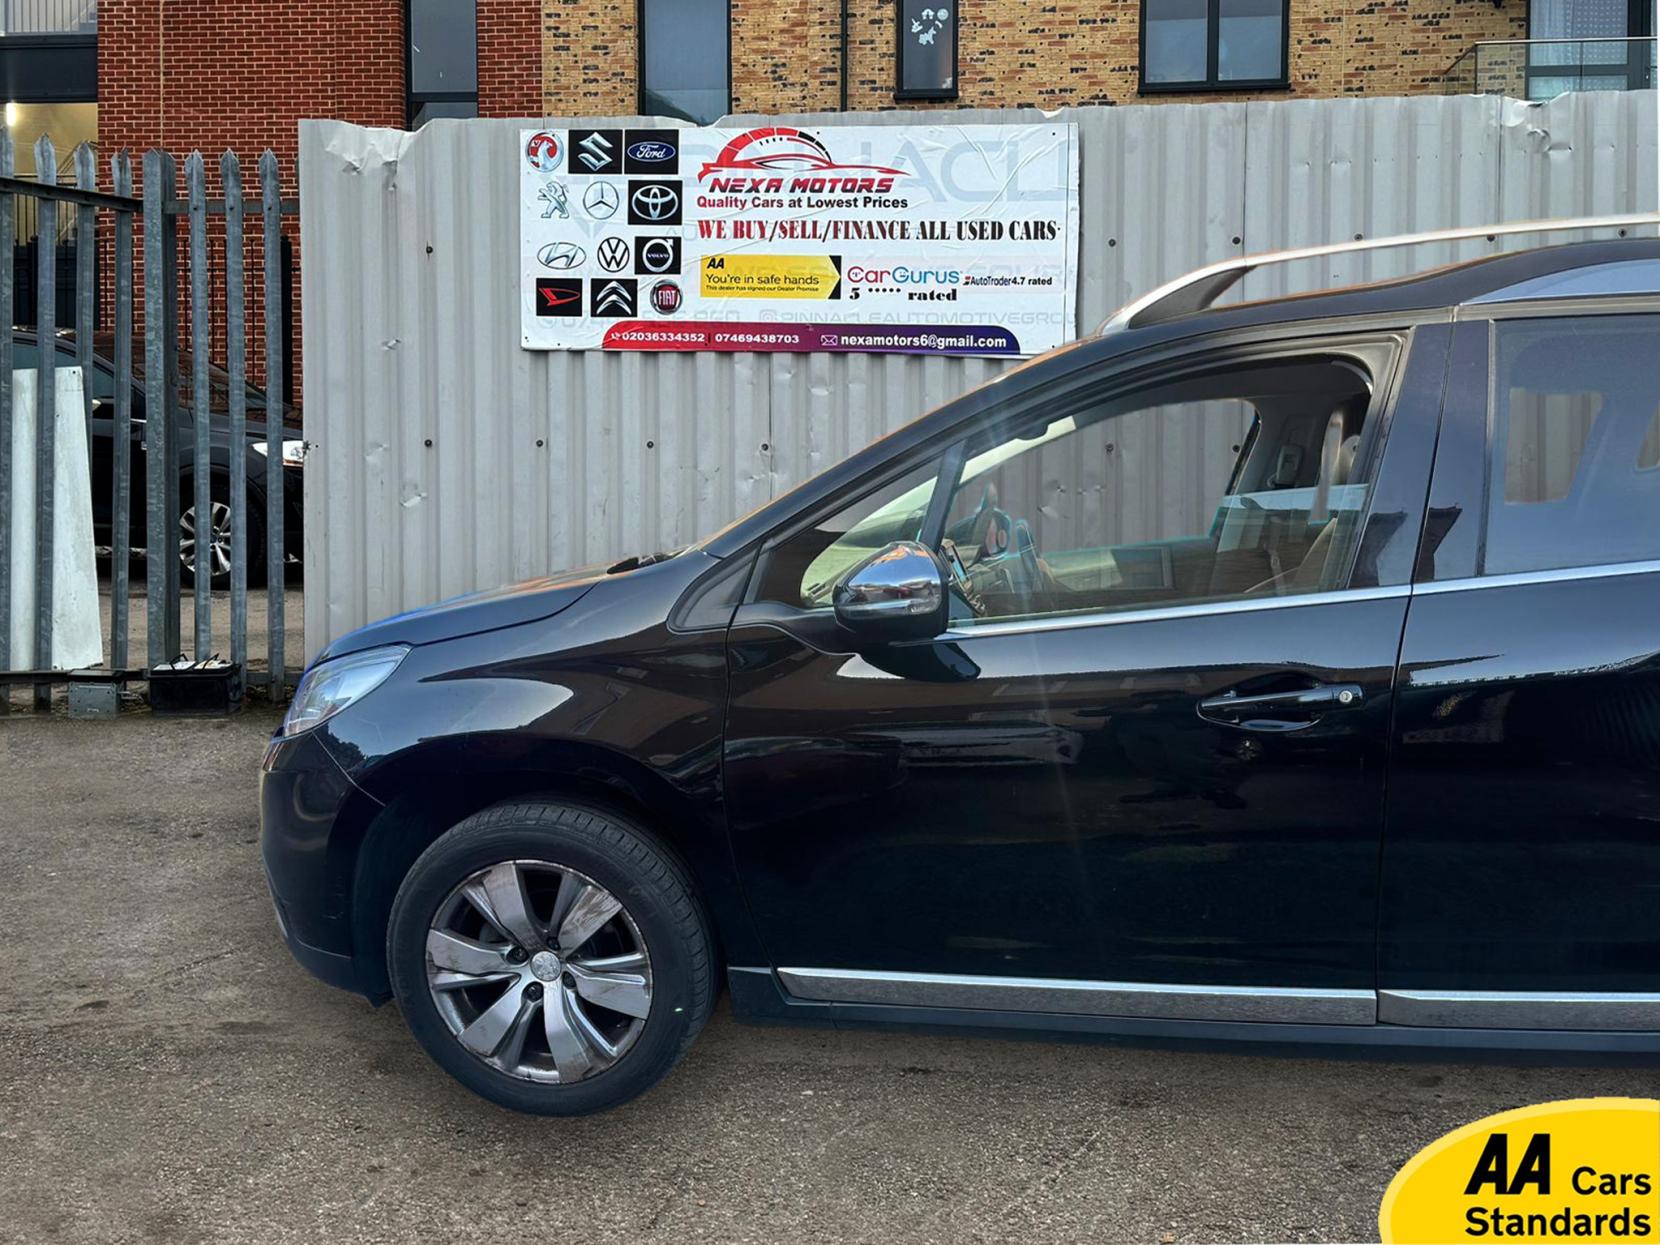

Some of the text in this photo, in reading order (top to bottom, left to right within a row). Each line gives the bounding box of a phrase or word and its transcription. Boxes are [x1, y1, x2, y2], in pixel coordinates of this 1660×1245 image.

[636, 144, 667, 159] Ford
[709, 177, 895, 193] NEXA MOTORS
[697, 196, 908, 210] Quality Cars at Lowest Prices
[698, 220, 727, 240] WE
[916, 220, 951, 240] ALL
[956, 220, 1003, 240] USED
[1008, 220, 1057, 240] CARS
[707, 257, 725, 269] AA
[706, 273, 820, 285] You're in safe hands
[847, 266, 960, 284] CarGurus
[1011, 276, 1026, 286] 4.7
[1028, 276, 1053, 286] rated
[658, 290, 676, 305] FIAT
[849, 287, 957, 301] 5 rated
[622, 332, 800, 343] 02036334352 07469438703
[840, 334, 1006, 350] nexamotors6@gmail.com
